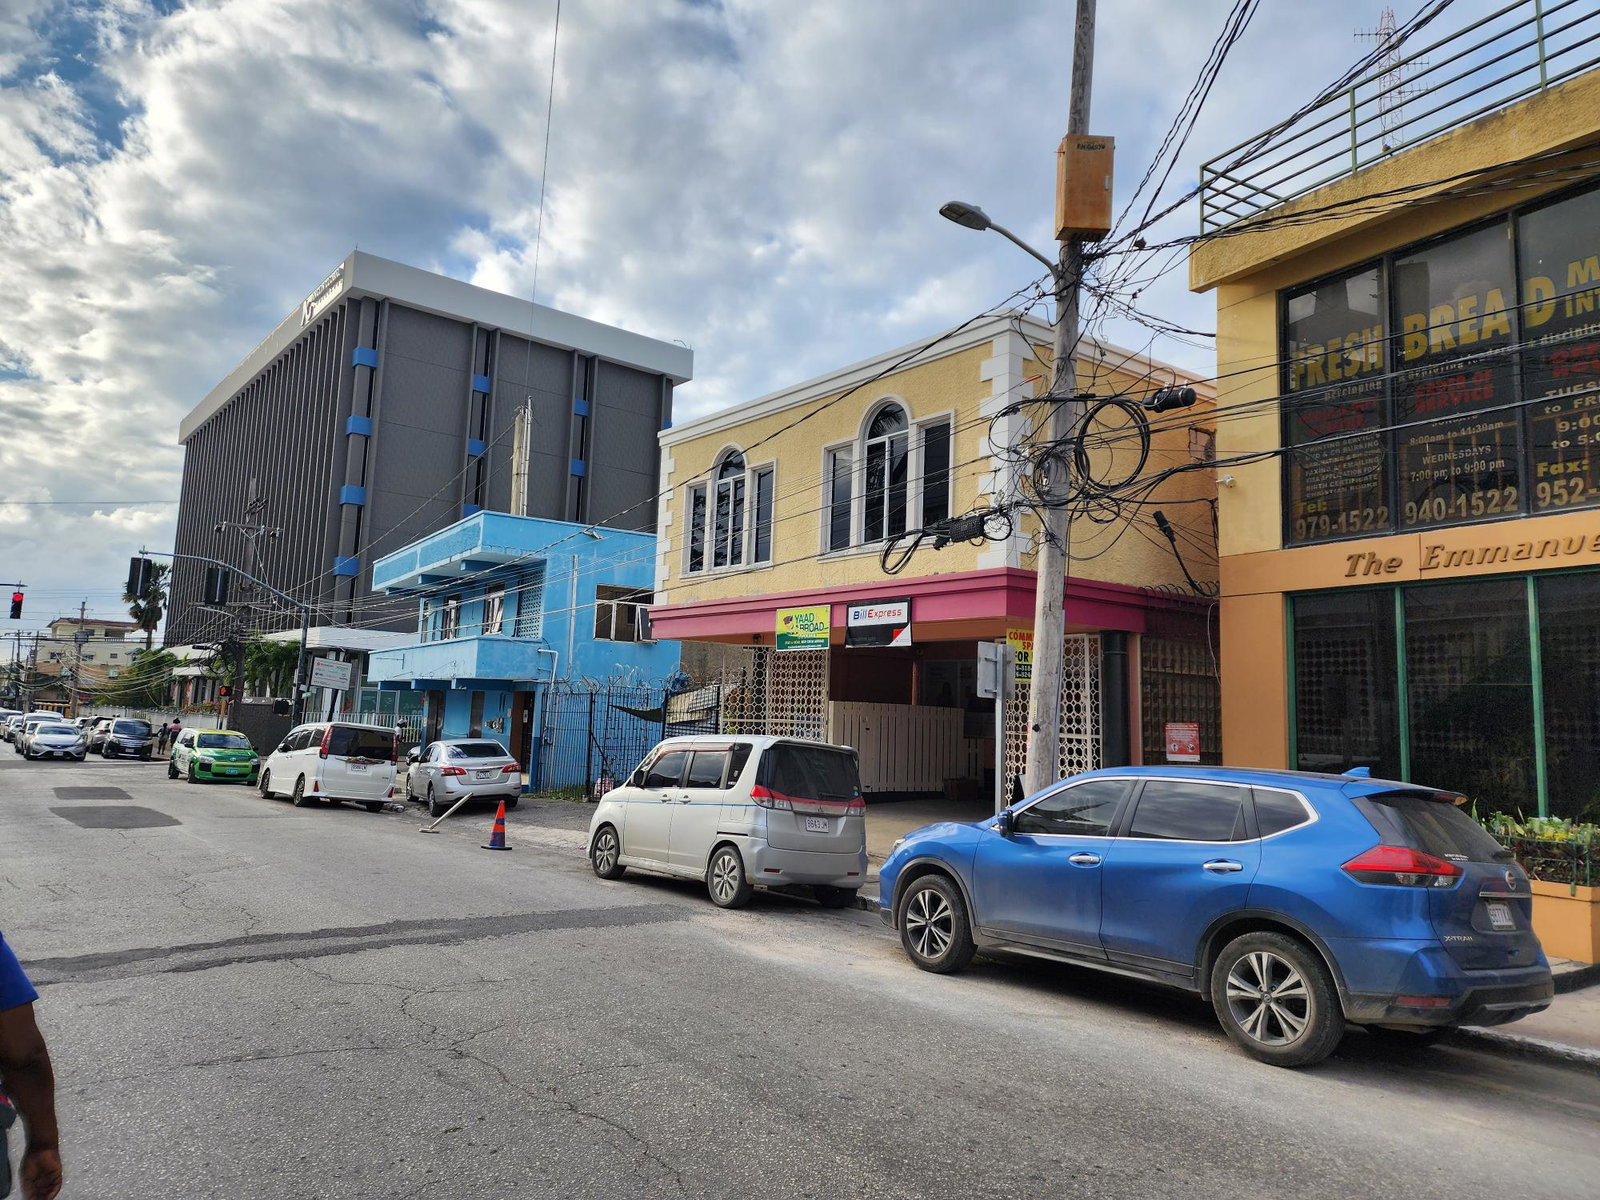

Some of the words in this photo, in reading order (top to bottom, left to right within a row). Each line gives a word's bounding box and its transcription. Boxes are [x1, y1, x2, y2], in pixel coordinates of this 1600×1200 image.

[1291, 324, 1384, 392] FRESH
[1544, 405, 1561, 414] to
[1422, 445, 1491, 465] WEDNESDAYS
[1552, 440, 1570, 449] to
[1410, 469, 1431, 482] 7:00
[1451, 466, 1461, 476] to
[1464, 460, 1486, 474] 9:00
[1489, 460, 1505, 472] pm
[1537, 459, 1590, 478] Fax:
[1405, 486, 1518, 524] 940-1522
[1295, 504, 1389, 540] 979-1522
[1344, 551, 1403, 578] The
[1009, 631, 1034, 641] COMM
